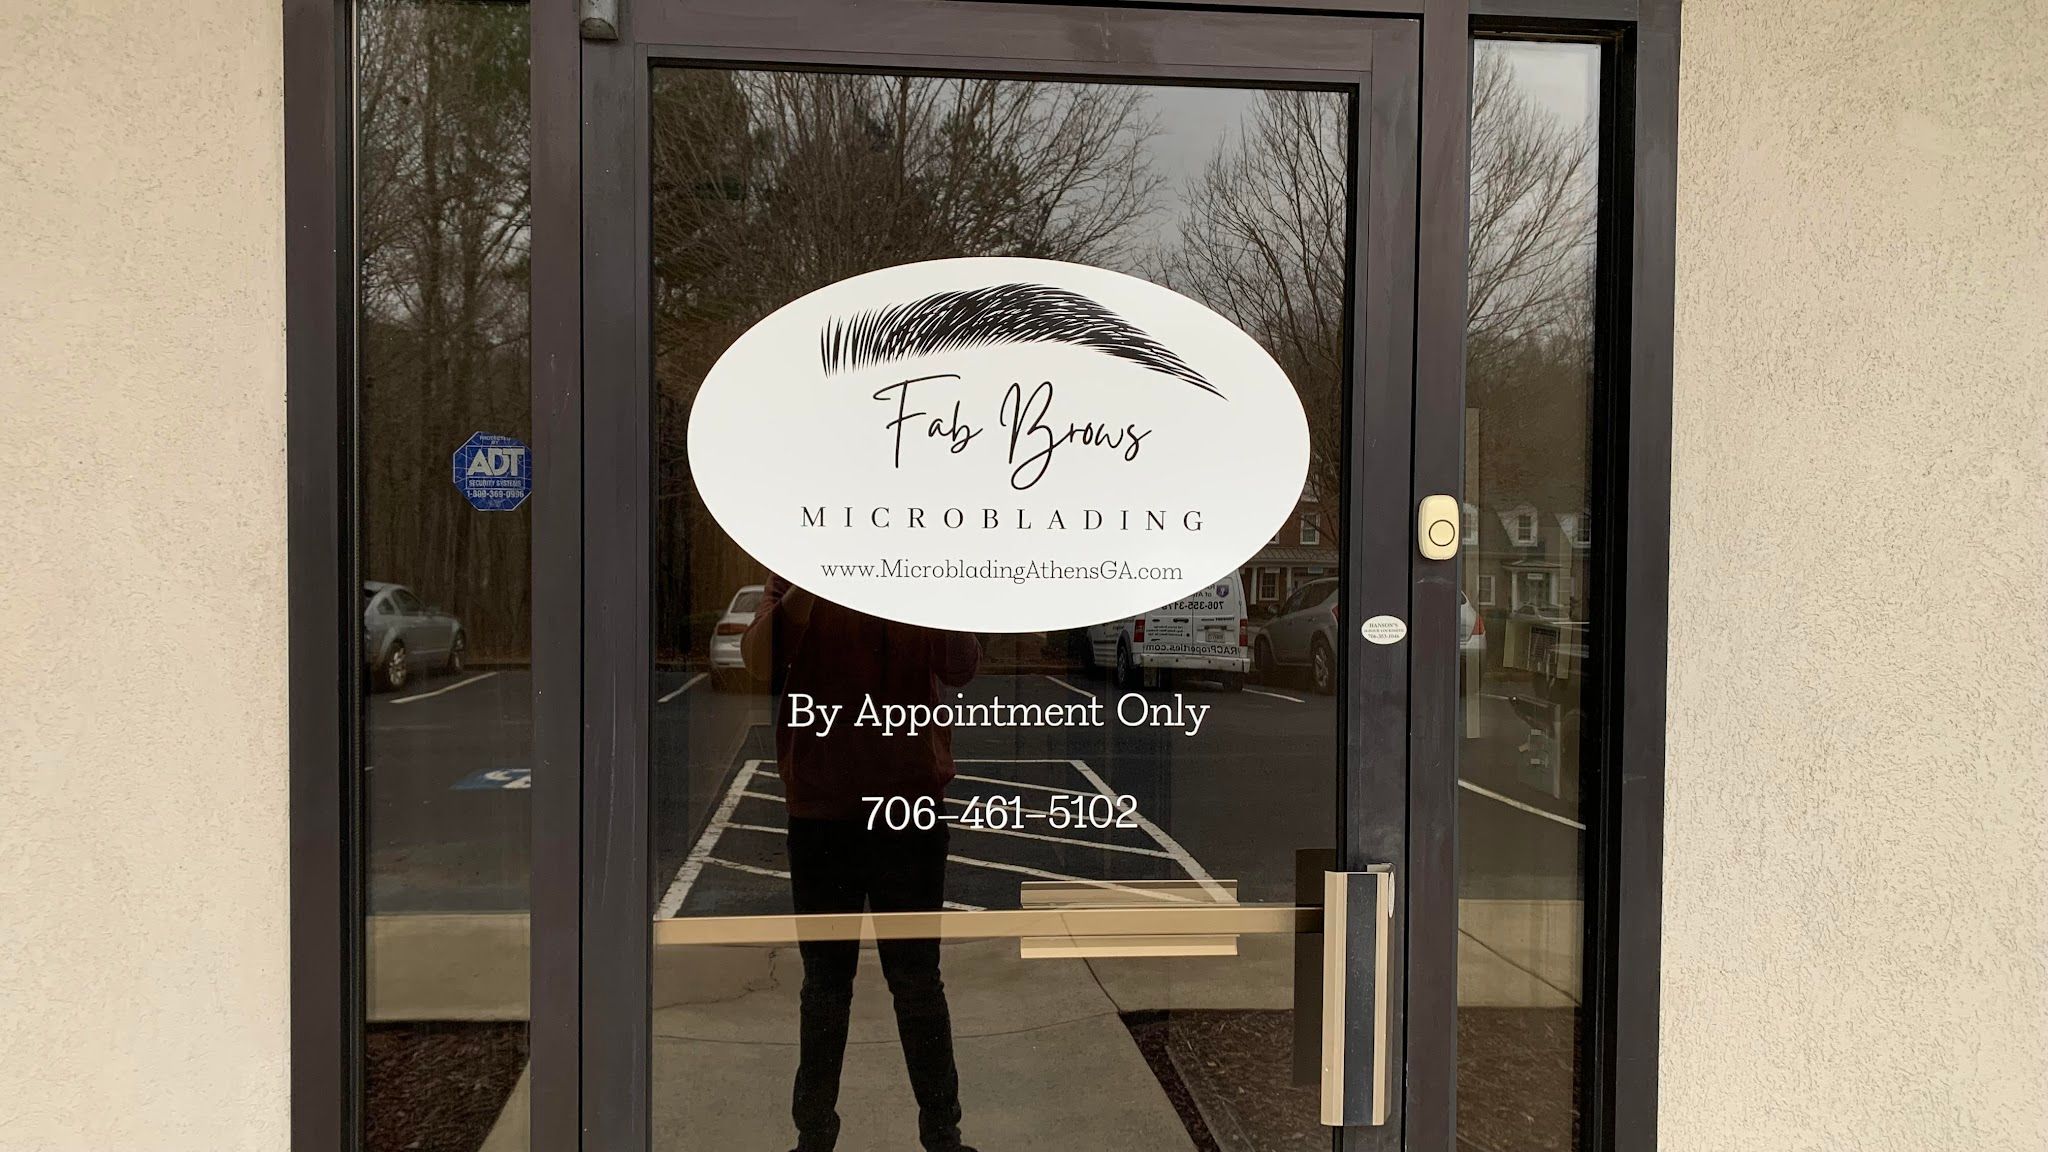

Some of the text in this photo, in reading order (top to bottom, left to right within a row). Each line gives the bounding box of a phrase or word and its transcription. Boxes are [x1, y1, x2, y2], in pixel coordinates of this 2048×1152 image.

[872, 373, 1153, 490] Fab Brows
[467, 448, 525, 477] ADT
[800, 506, 1204, 532] MICROBLADING
[820, 558, 1184, 585] www.MicrobladingAthensGA.com
[787, 692, 1211, 737] By Appointment Only
[861, 794, 1139, 831] 706-461-5102
